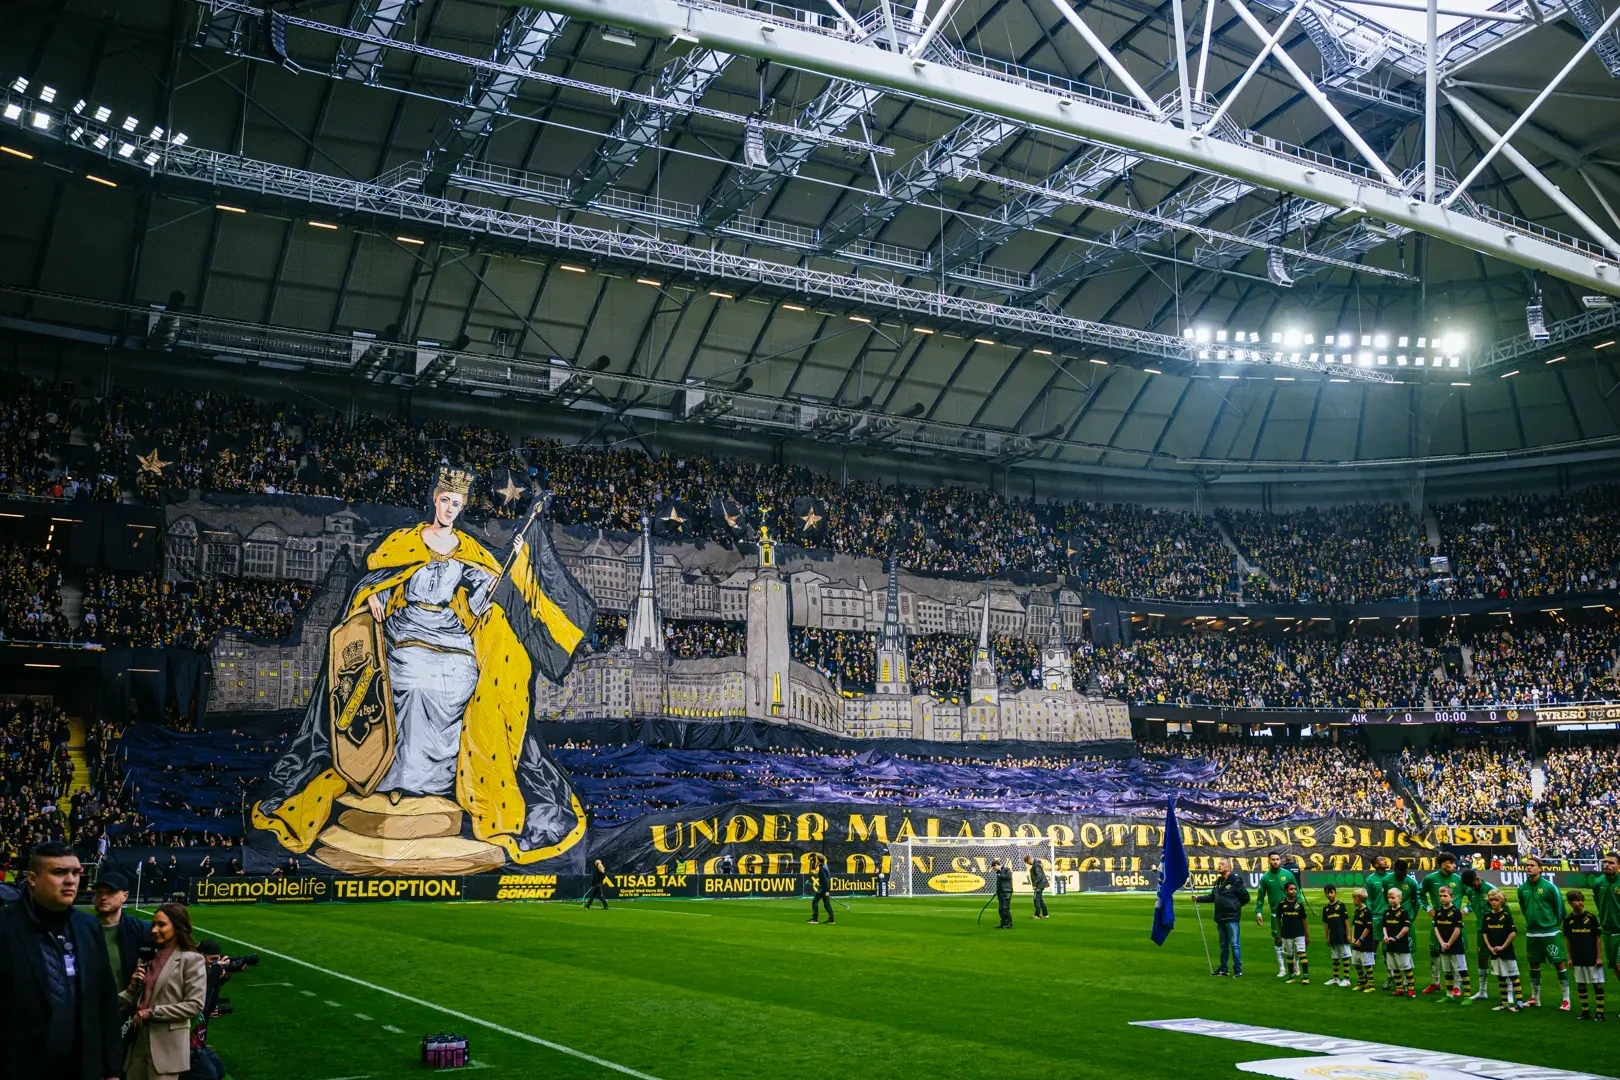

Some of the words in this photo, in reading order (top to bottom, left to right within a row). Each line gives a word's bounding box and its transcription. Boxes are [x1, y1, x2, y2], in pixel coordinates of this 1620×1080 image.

[1351, 713, 1367, 723] AIK
[1405, 713, 1412, 723] 0
[1435, 712, 1467, 722] 00:00
[1490, 711, 1497, 721] 0
[1536, 708, 1586, 720] TYRESÖ
[650, 812, 829, 853] UNDER
[498, 875, 557, 885] BRUNNA
[615, 875, 656, 887] TISAB
[660, 875, 687, 887] TAK
[705, 878, 796, 892] BRANDTOWN
[197, 878, 326, 896] themobilelife
[335, 880, 461, 897] TELEOPTION.
[496, 888, 555, 899] SCHAKT
